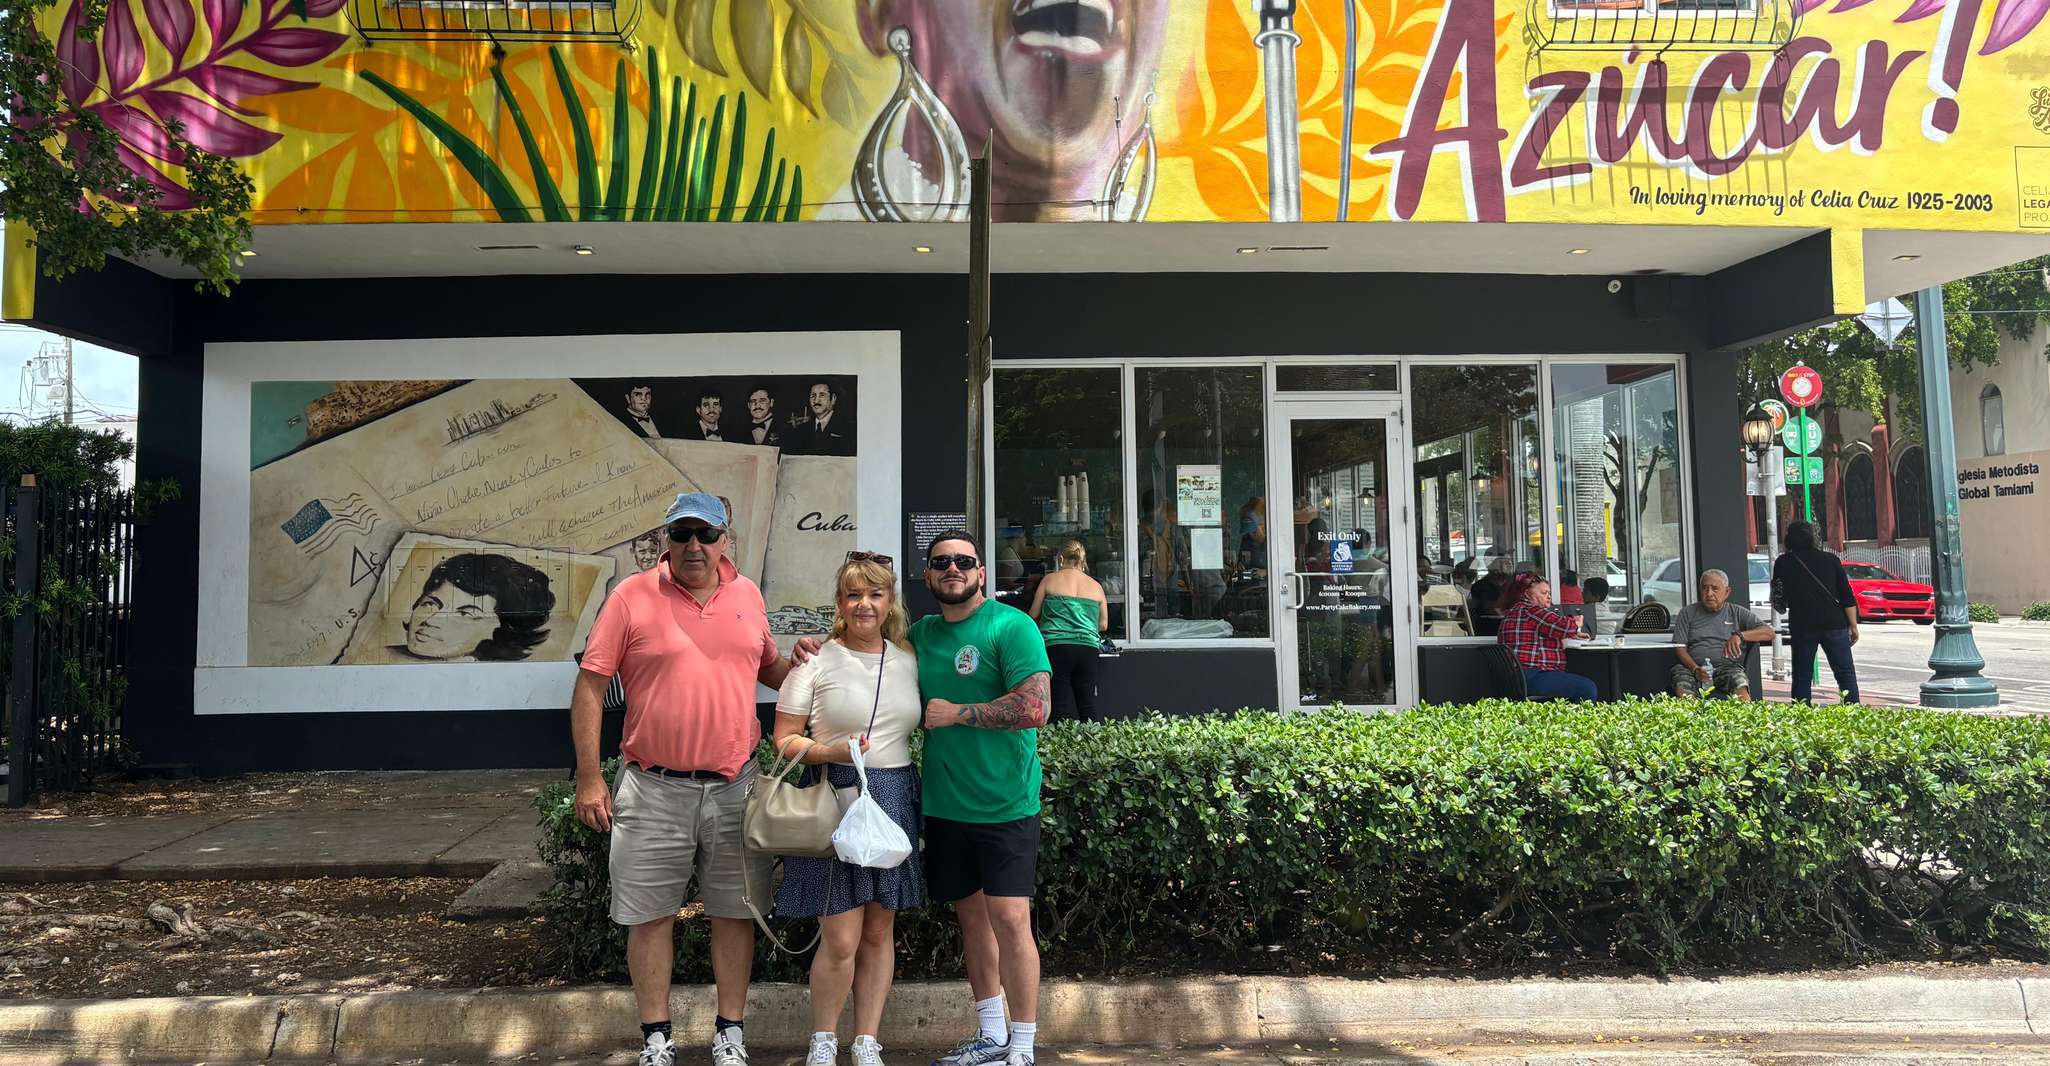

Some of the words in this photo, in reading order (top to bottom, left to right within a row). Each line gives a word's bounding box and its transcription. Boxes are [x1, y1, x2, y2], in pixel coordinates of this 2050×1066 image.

[1366, 0, 1979, 222] Azúcar!
[1630, 186, 1651, 205] In
[1656, 186, 1707, 215] loving
[1710, 192, 1786, 216] memory
[1789, 190, 1805, 206] of
[1810, 190, 1854, 209] Celia
[1857, 191, 1900, 210] Cruz
[1907, 192, 1993, 211] 1925-2003
[1808, 422, 1817, 448] BUS
[1989, 463, 2039, 479] Metodista
[1958, 486, 1990, 500] Global
[1993, 481, 2034, 497] Tamiami
[797, 511, 857, 532] Cuba
[1317, 531, 1337, 541] Exit
[1338, 531, 1362, 542] Only
